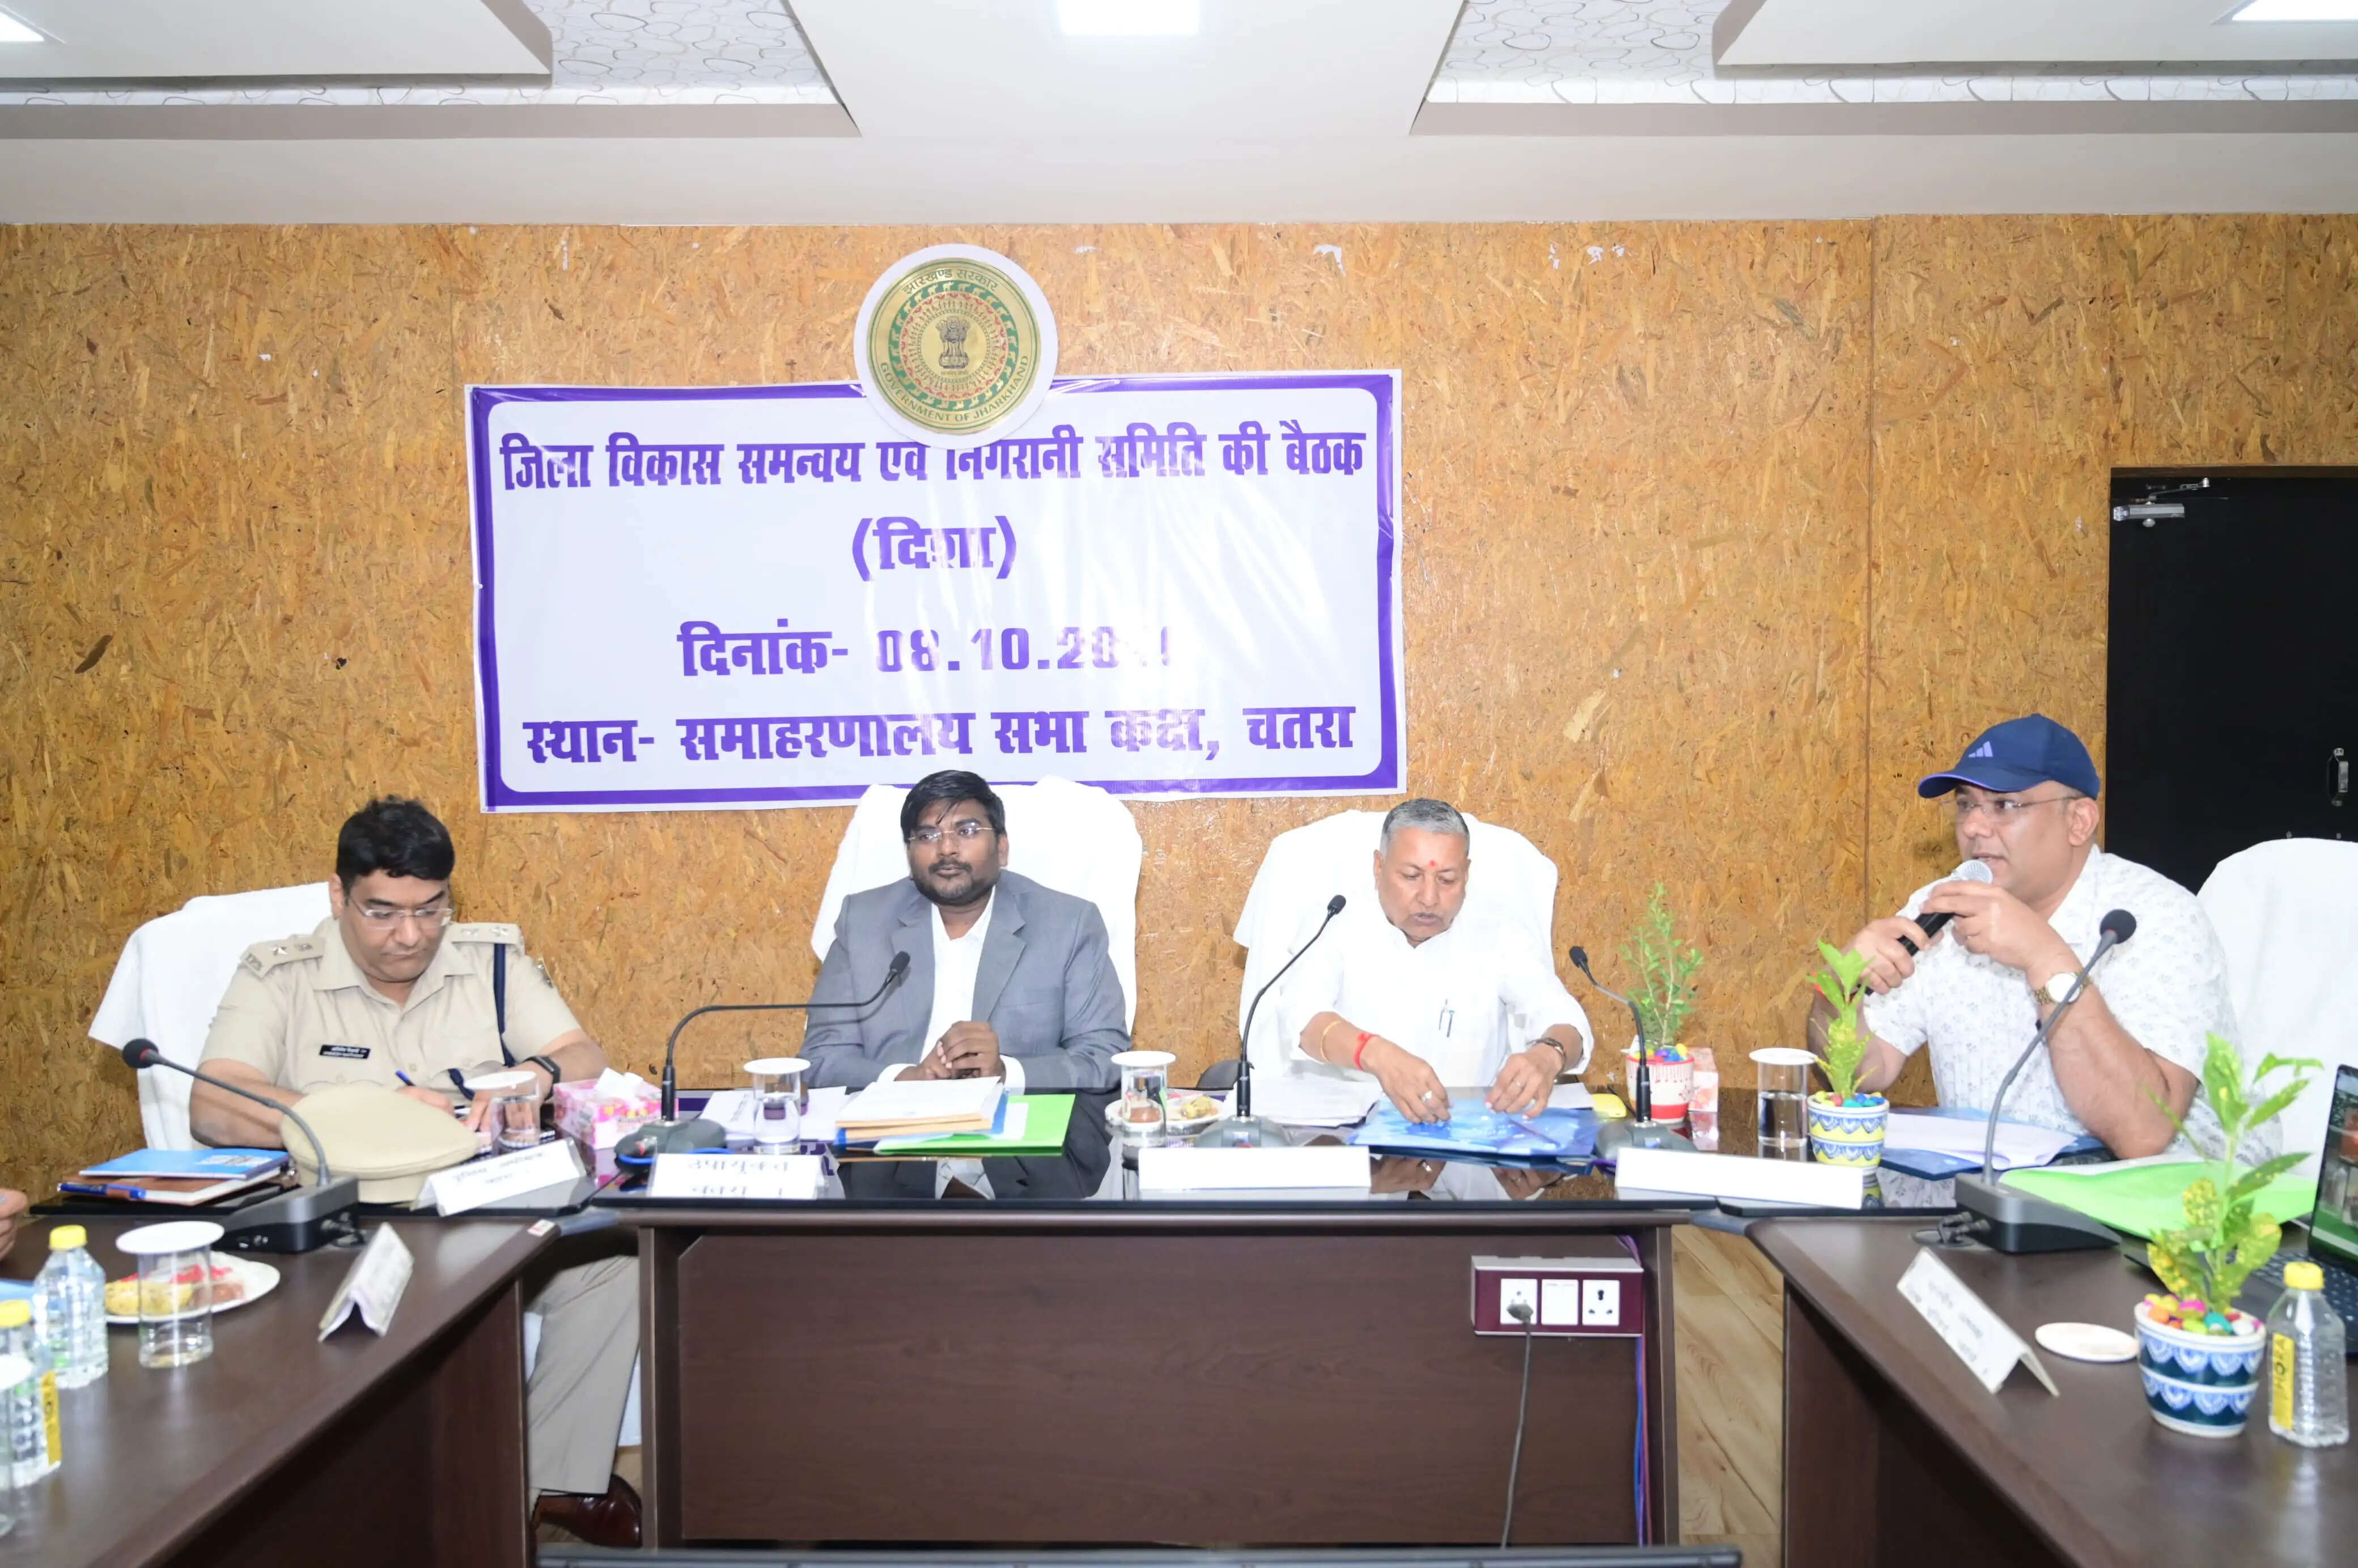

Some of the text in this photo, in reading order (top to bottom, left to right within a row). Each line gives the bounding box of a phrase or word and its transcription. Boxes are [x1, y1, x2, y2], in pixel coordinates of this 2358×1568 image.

[902, 268, 1000, 295] झारखण्ड सरकार
[880, 355, 1029, 422] GOVERNMENT OF JHARKHAND
[499, 432, 594, 491] जिला
[605, 432, 725, 487] विकास
[736, 443, 866, 484] समन्वय
[1095, 422, 1207, 478] समिति
[1218, 420, 1271, 475] की
[1279, 419, 1367, 475] बैठक
[852, 515, 1017, 581] (दिशा)
[676, 618, 848, 677] दिनांक-
[522, 706, 1356, 764] स्थान- समाहरणालय सभा कक्ष, चतरा
